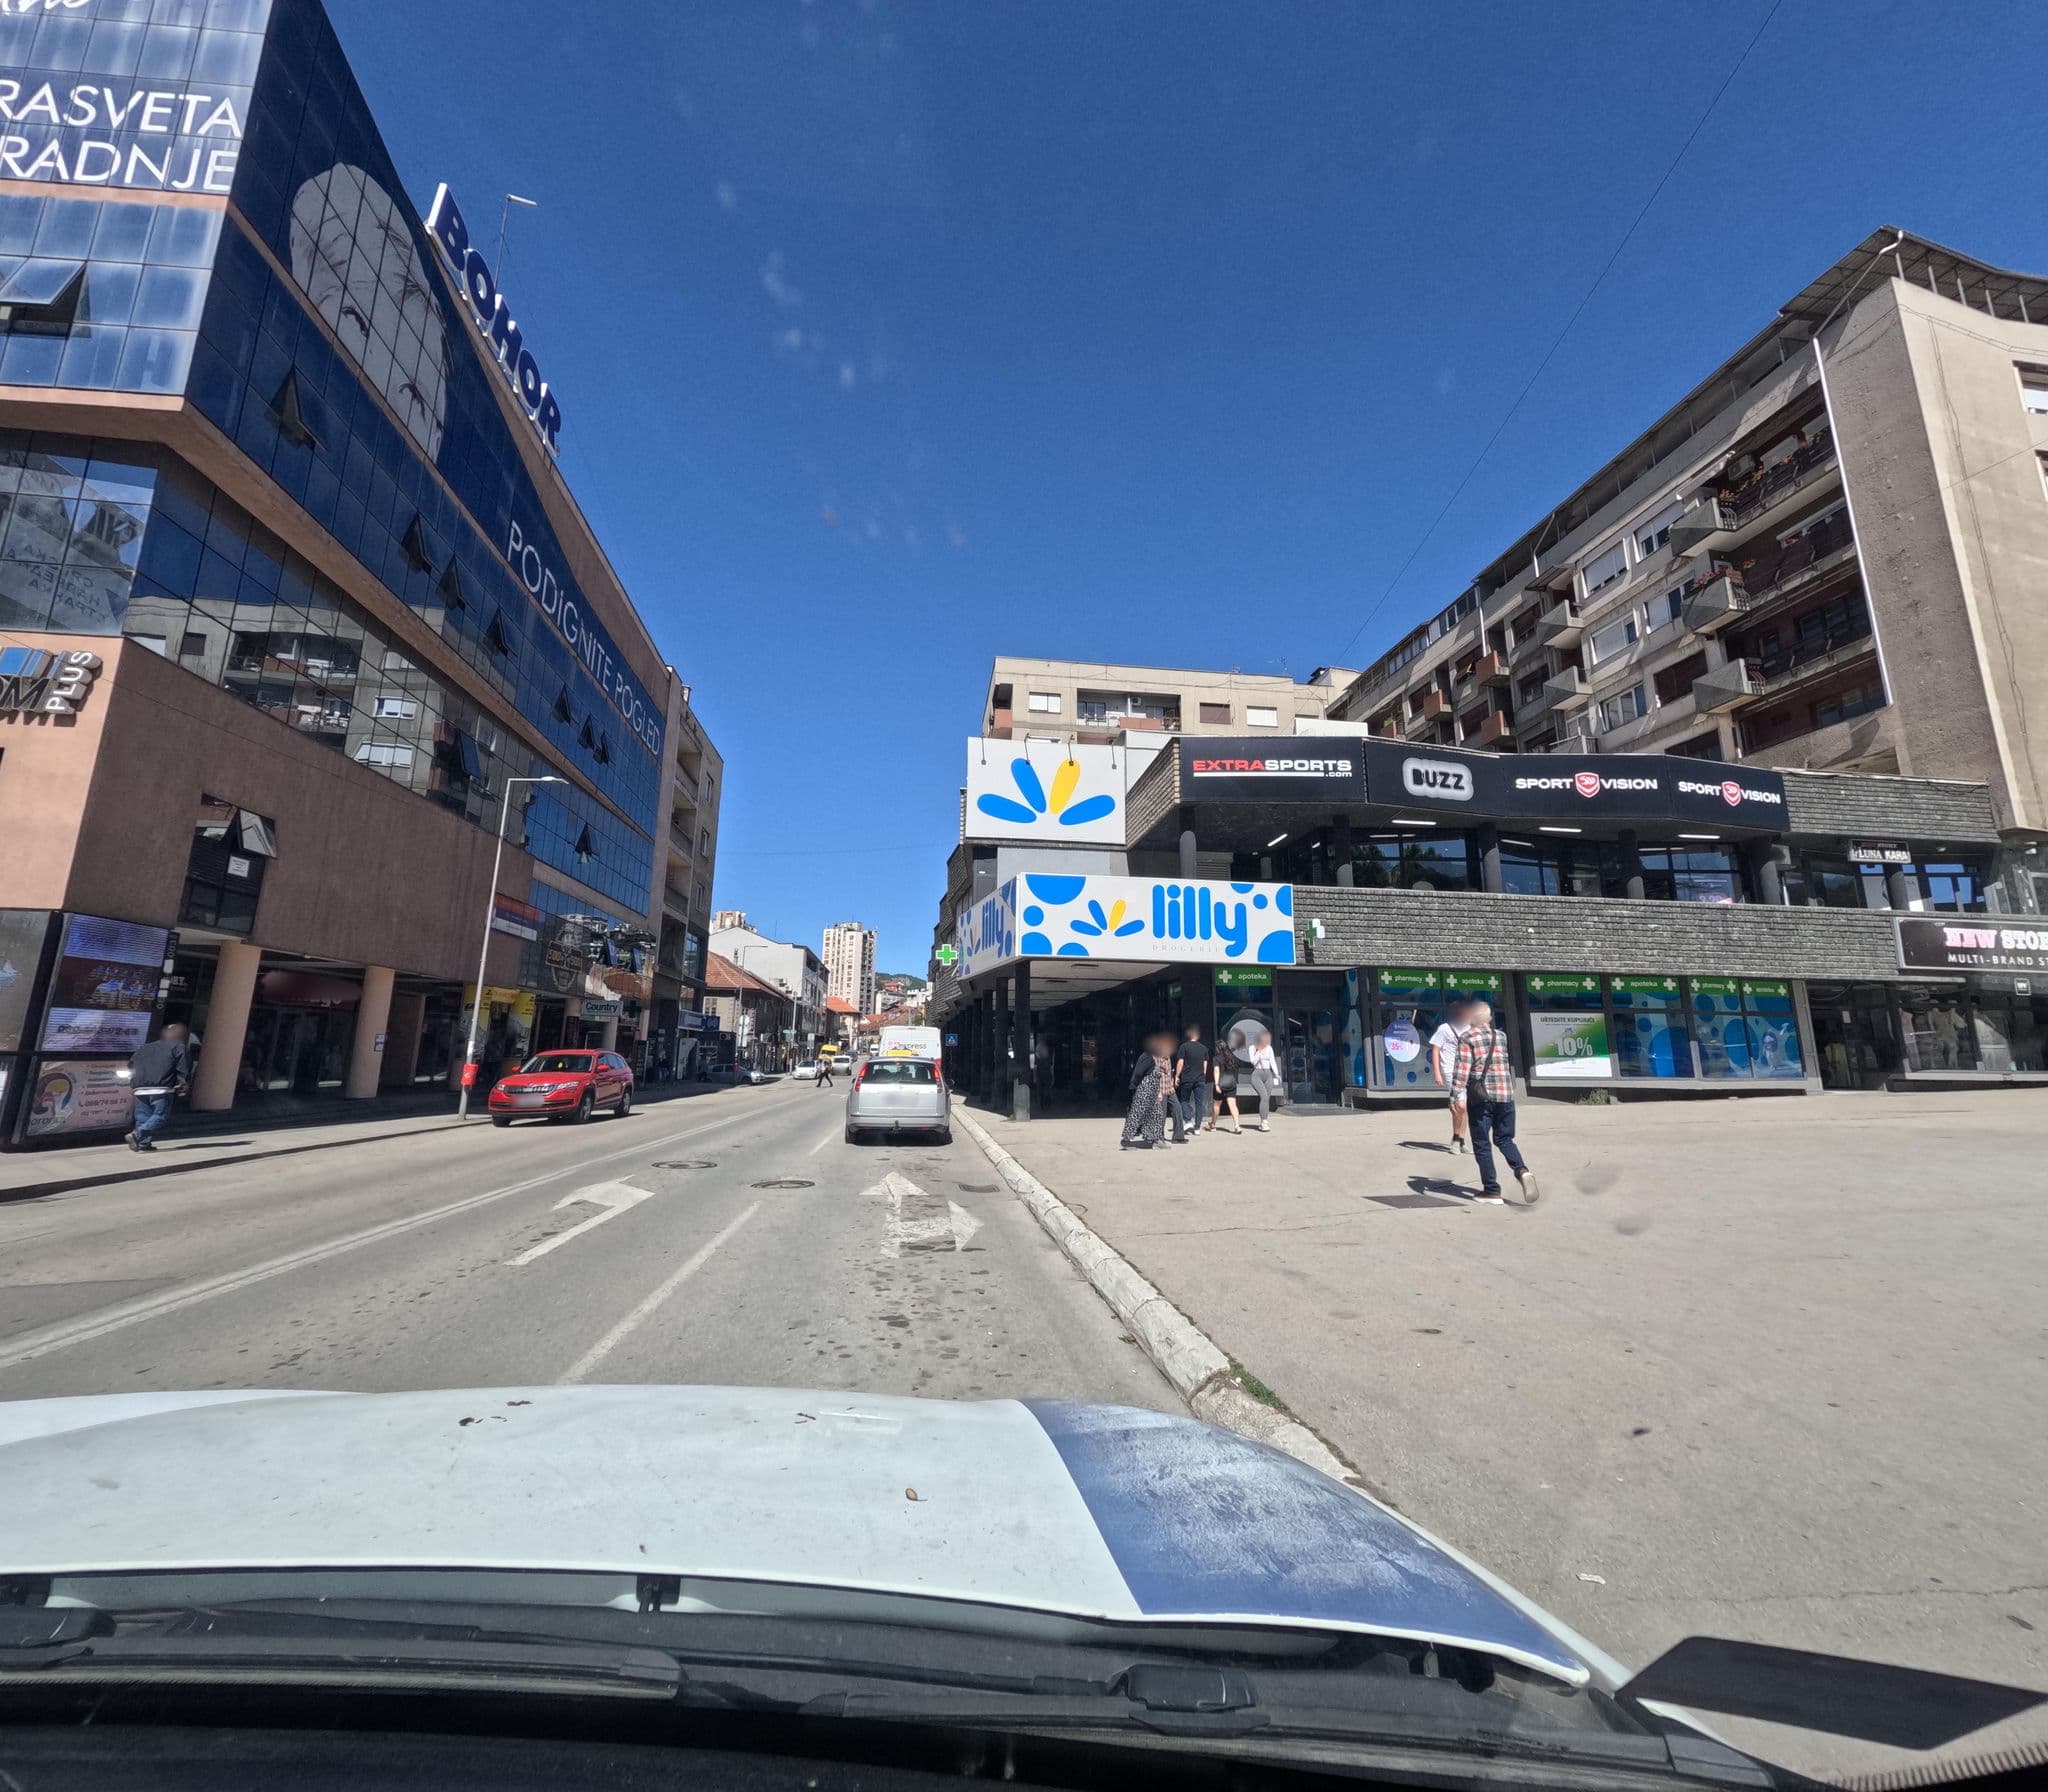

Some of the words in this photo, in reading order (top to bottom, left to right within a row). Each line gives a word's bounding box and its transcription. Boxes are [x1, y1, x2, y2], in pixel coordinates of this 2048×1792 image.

[0, 79, 242, 138] RASVETA
[425, 182, 561, 457] BOHOR
[507, 519, 613, 692] PODIGNITE
[614, 671, 661, 756] POGLED
[45, 651, 93, 710] PLUS
[1192, 759, 1352, 772] EXTRASPORTS
[1412, 768, 1466, 791] BUZZ
[1515, 777, 1574, 790] SPORT
[1600, 778, 1658, 790] VISION
[1678, 780, 1722, 797] SPORT
[1741, 790, 1781, 805] VISION
[981, 897, 1005, 959] lilly
[1152, 884, 1248, 958] lilly
[1947, 953, 2034, 967] MULTI-BRAND
[1237, 972, 1267, 982] apoteka
[1394, 974, 1423, 984] pharmacy
[1546, 980, 1579, 988] pharmacy
[585, 1002, 619, 1012] Country
